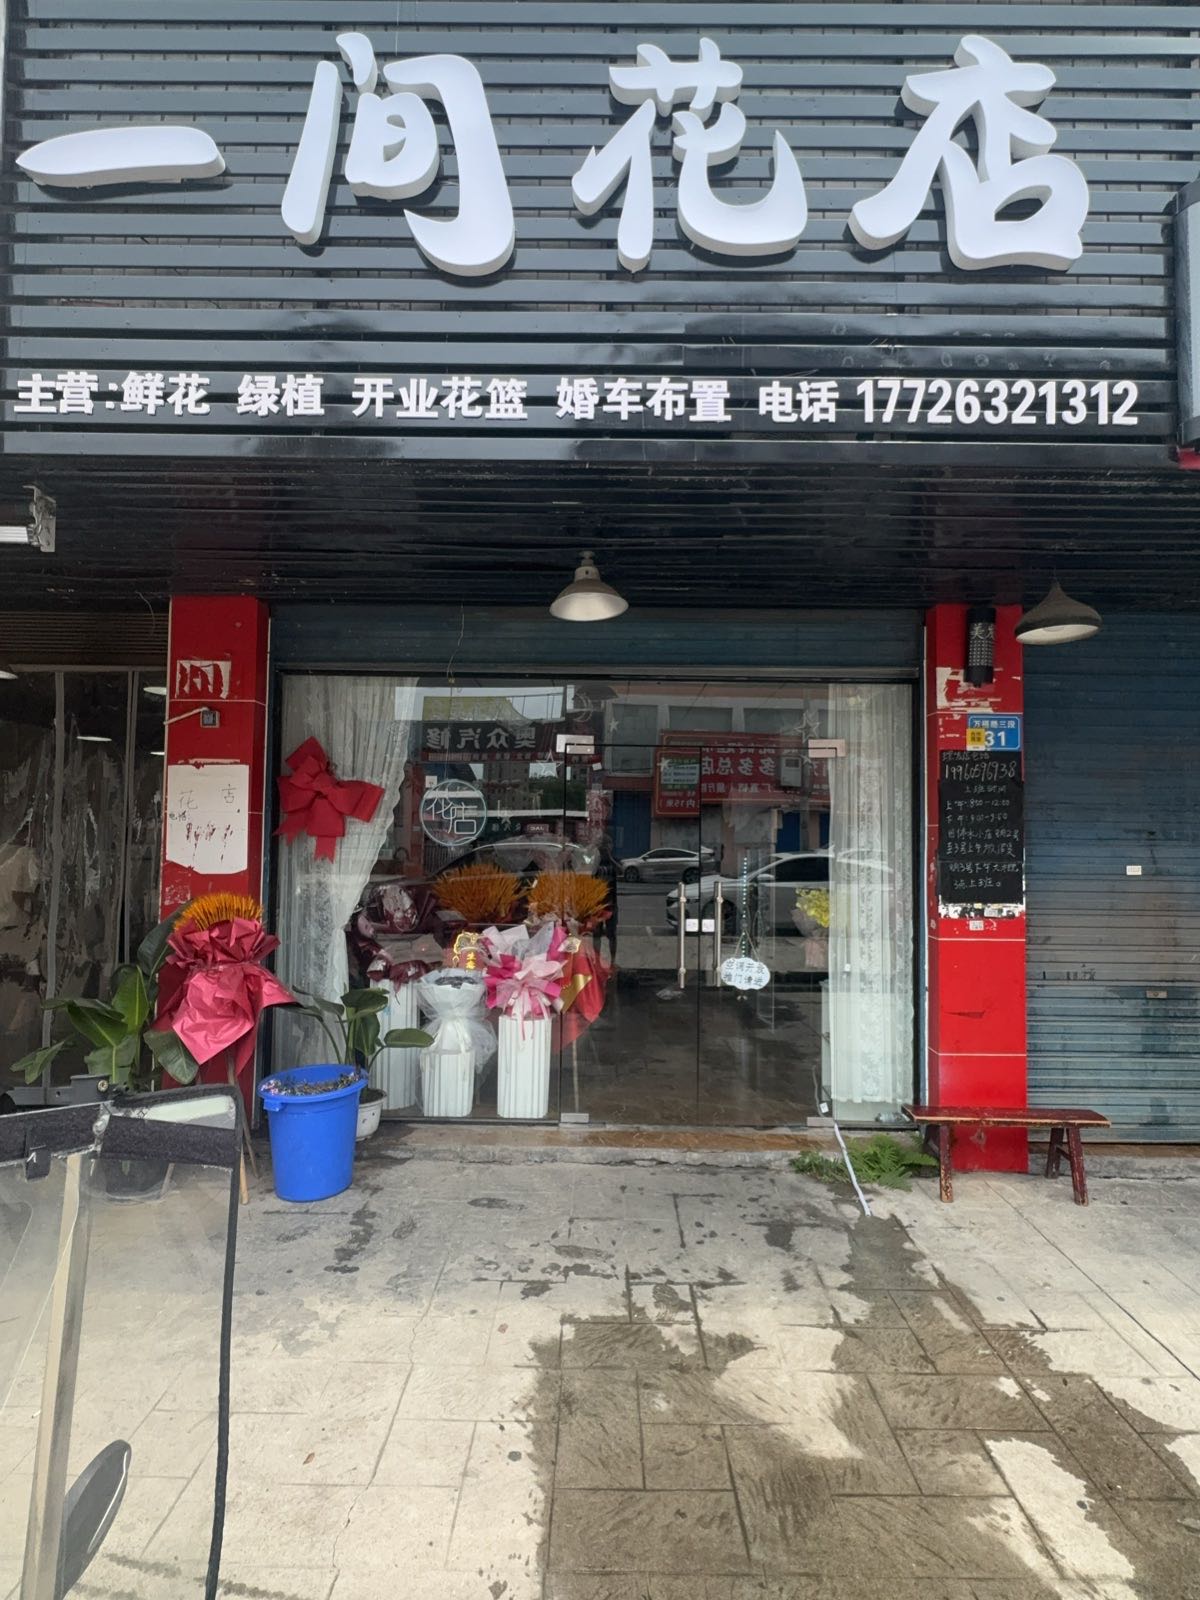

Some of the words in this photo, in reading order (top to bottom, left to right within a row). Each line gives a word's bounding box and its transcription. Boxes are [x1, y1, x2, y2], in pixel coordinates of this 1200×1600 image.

[15, 32, 1090, 276] 一间花店
[236, 373, 325, 418] 绿植
[351, 376, 529, 420] 开业花篮
[555, 376, 732, 422] 婚车布置
[758, 379, 840, 424] 电话
[856, 378, 1139, 426] 17726321312
